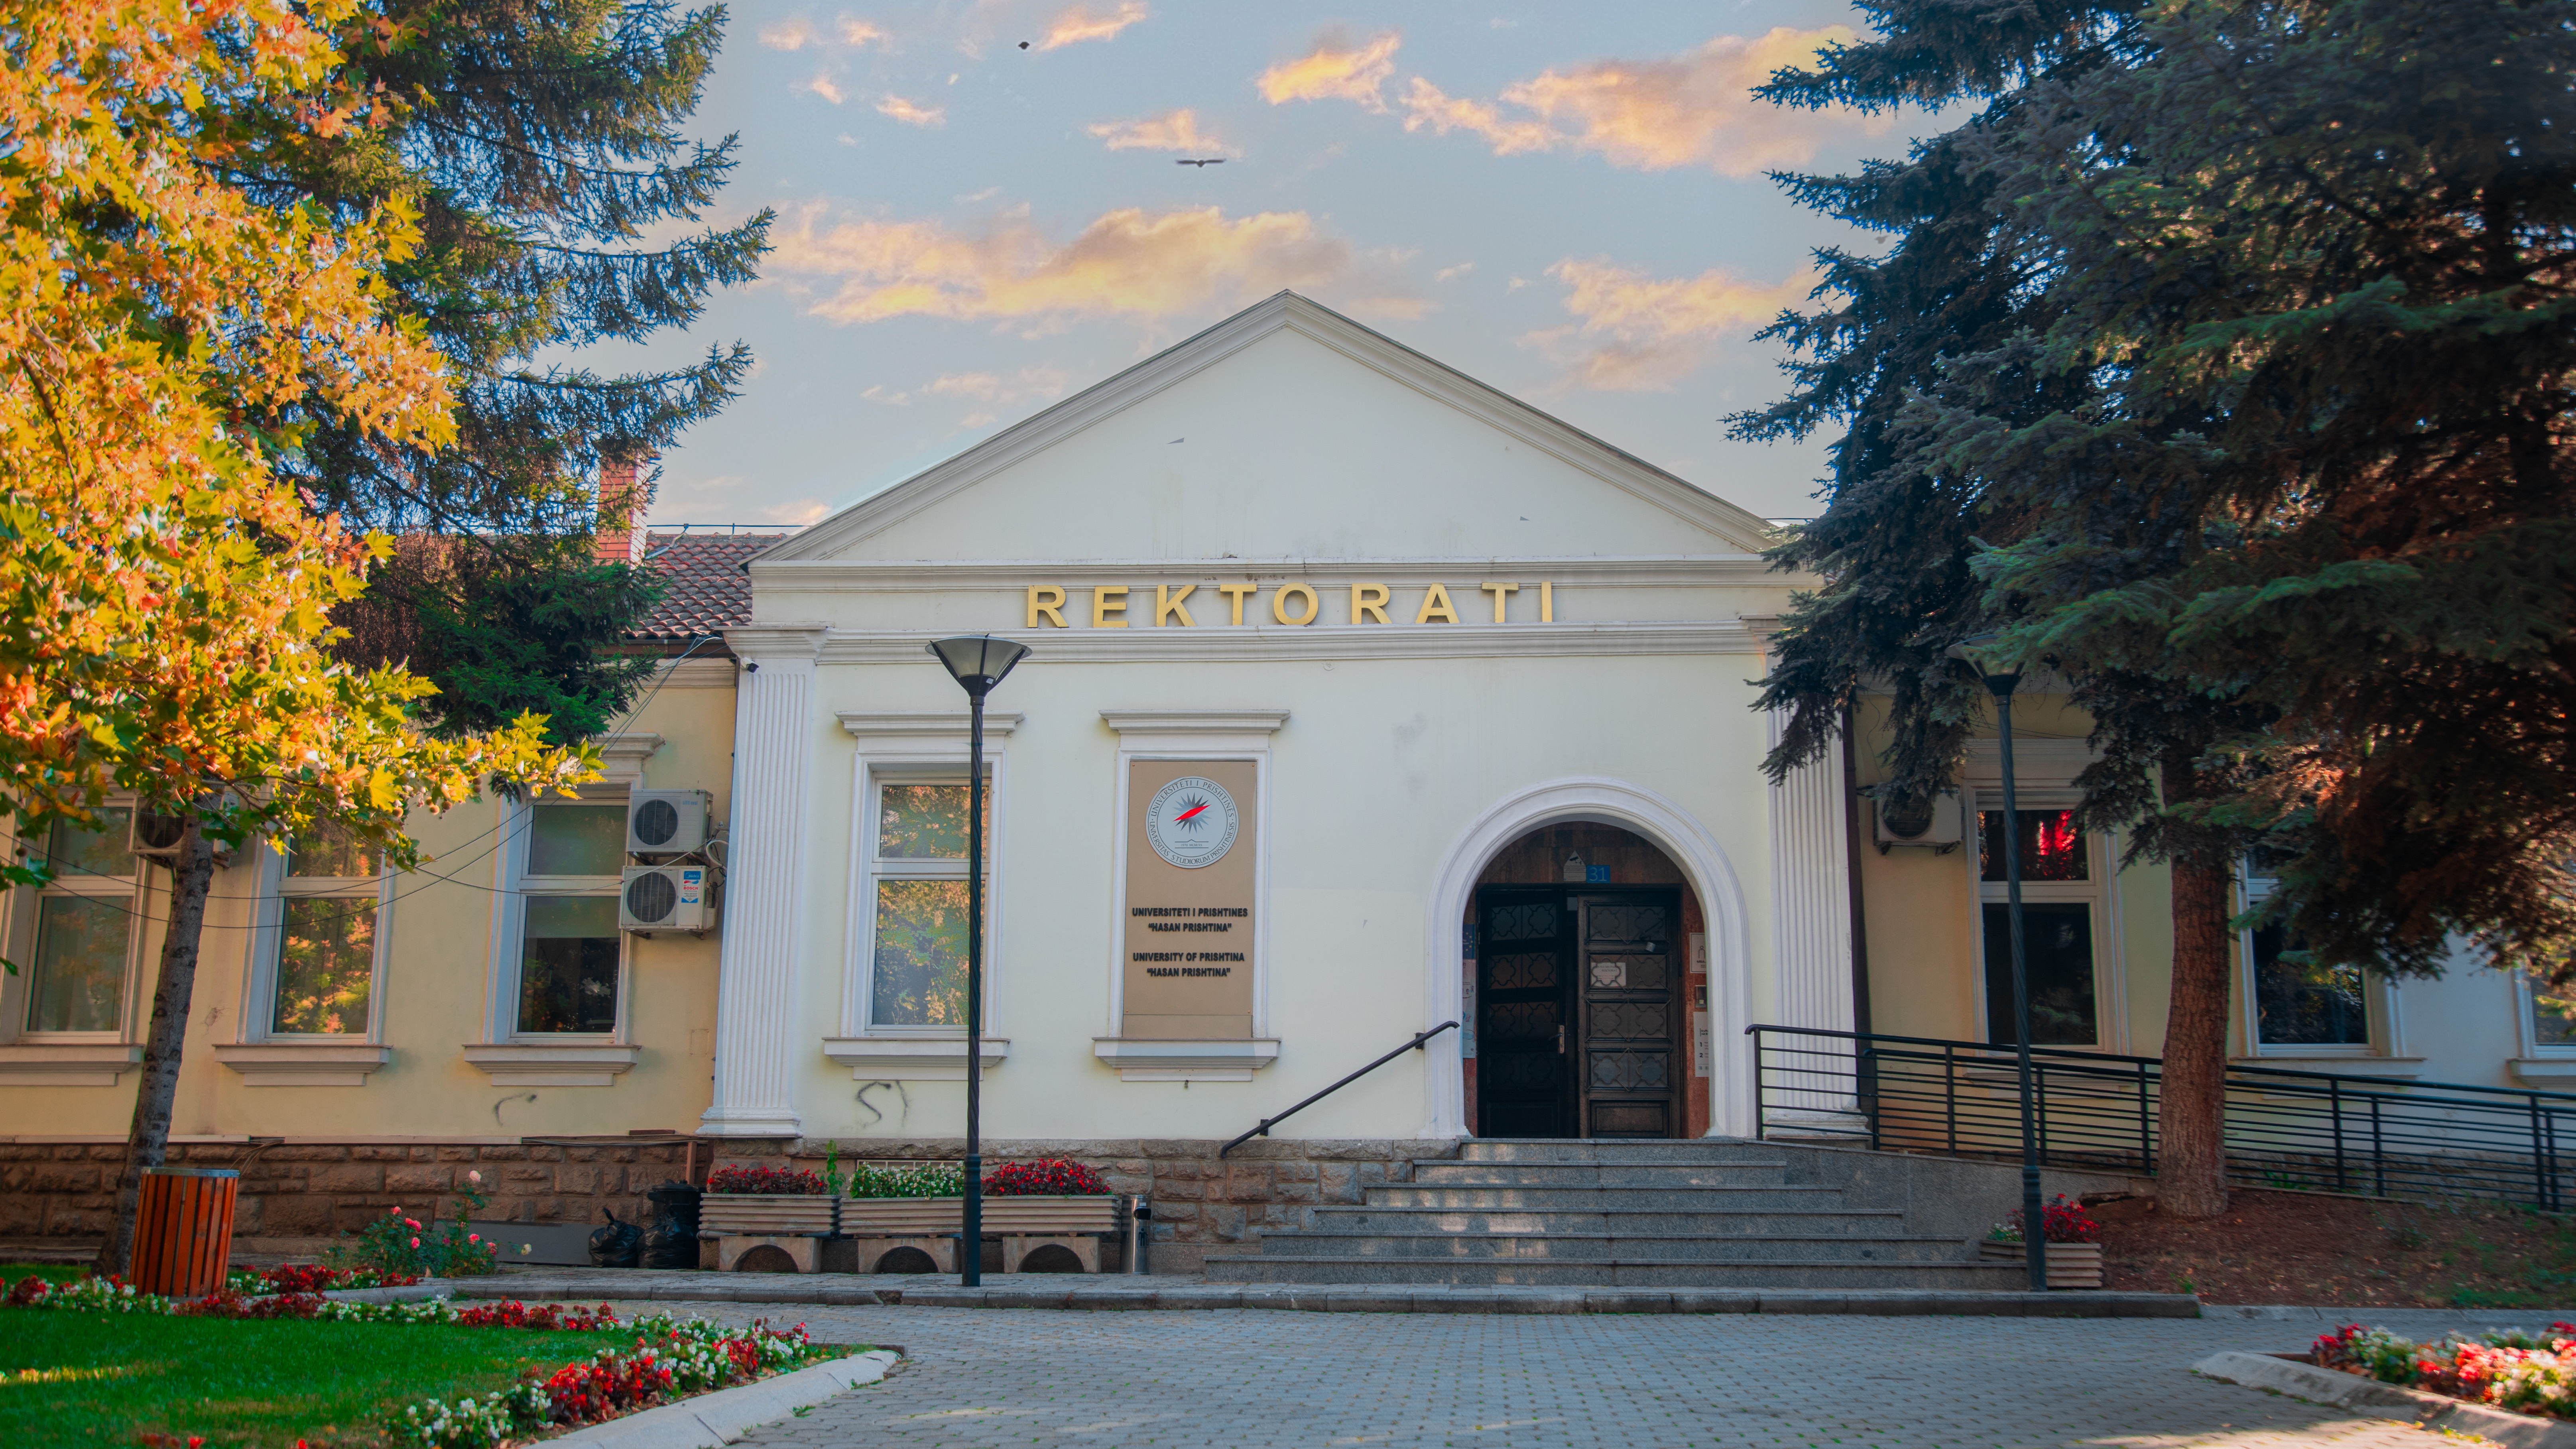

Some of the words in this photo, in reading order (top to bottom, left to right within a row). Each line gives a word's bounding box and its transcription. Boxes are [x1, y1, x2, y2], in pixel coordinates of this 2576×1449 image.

[1027, 581, 1553, 628] REKTORATI
[1151, 780, 1192, 817] UNIVERSITETI
[1203, 781, 1235, 817] PRISHTINËS
[1149, 821, 1171, 856] UNIVERSITAS
[1171, 854, 1210, 864] STUDIORUM
[1590, 867, 1607, 881] 31
[1132, 908, 1190, 916] UNIVERSITETI
[1193, 908, 1195, 916] I
[1133, 953, 1184, 961] UNIVERSITY
[1186, 953, 1197, 961] OF
[1200, 953, 1245, 961] PRISHTINA
